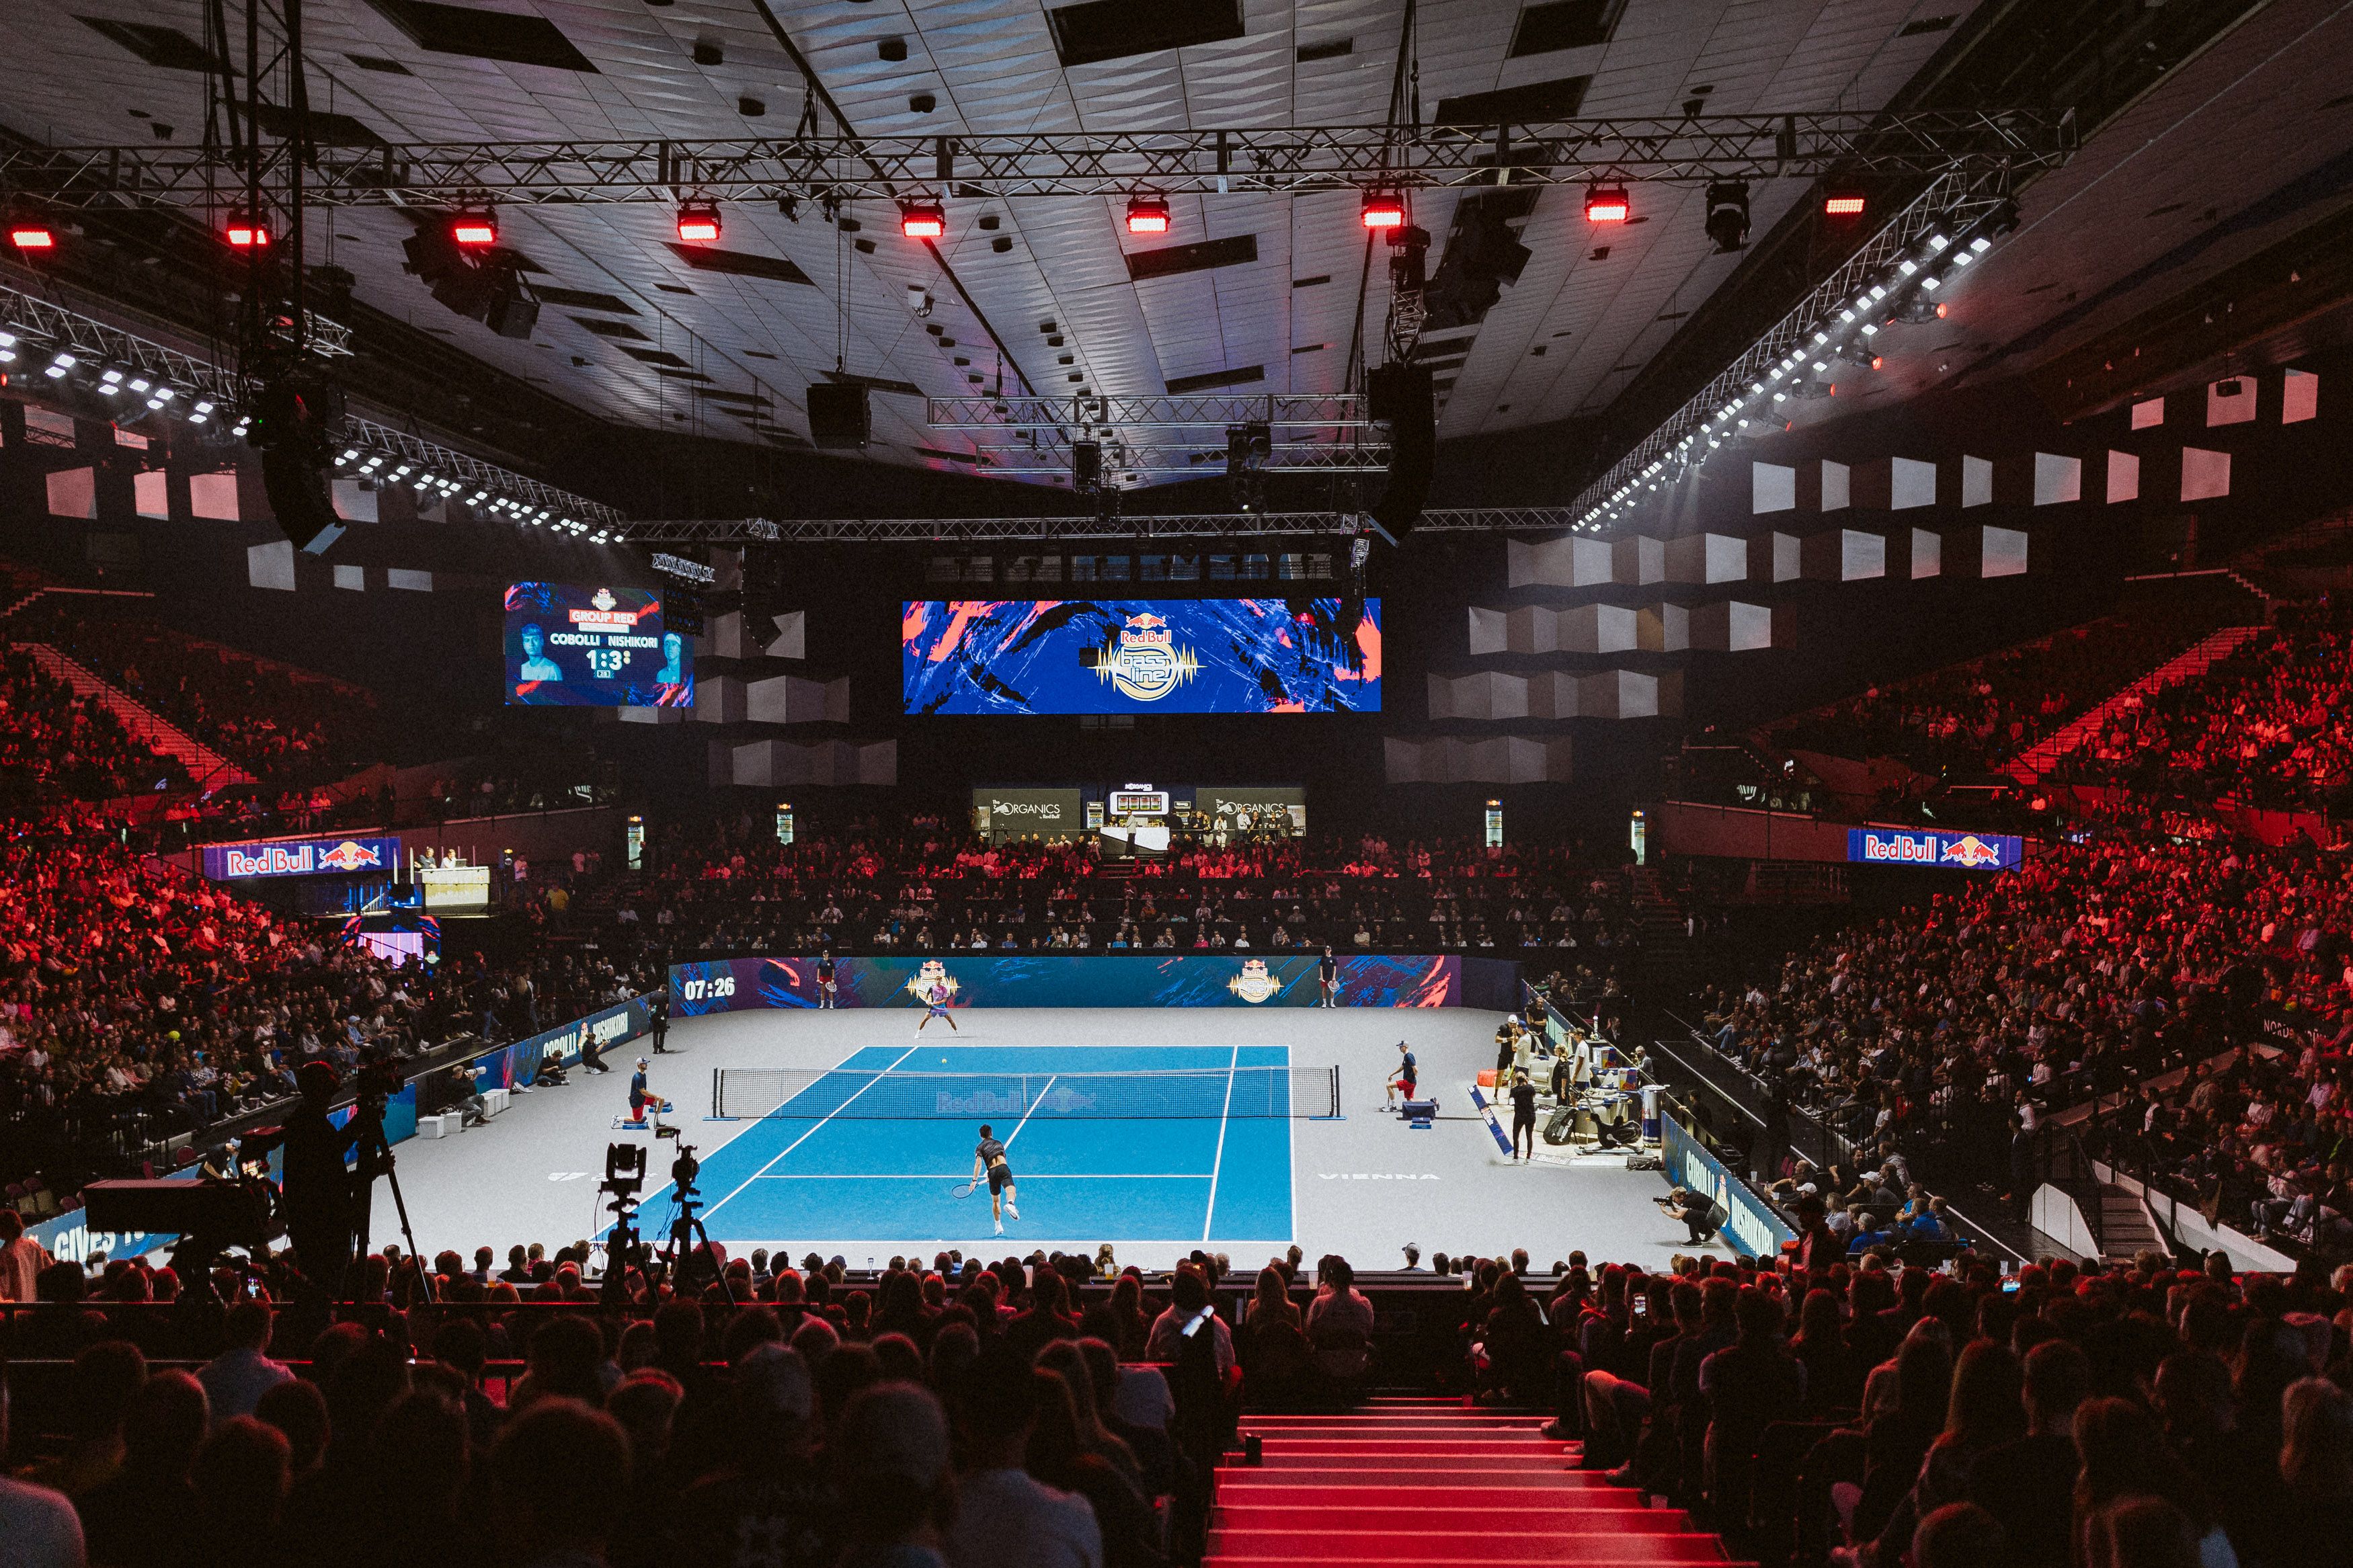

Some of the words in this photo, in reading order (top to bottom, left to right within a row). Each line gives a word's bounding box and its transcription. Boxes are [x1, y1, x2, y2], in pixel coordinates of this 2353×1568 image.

[572, 611, 611, 622] GROUP
[613, 613, 635, 623] RED
[550, 633, 600, 646] COBOLLI
[608, 636, 658, 648] NISHIKORI
[1121, 630, 1146, 643] Red
[1148, 630, 1171, 643] Bull
[1002, 802, 1060, 815] ORGANICS
[1866, 835, 1900, 858] Red
[1901, 837, 1936, 861] Bull
[229, 848, 271, 875] Red
[273, 846, 313, 872] Bull
[685, 977, 735, 1000] 07:26
[1686, 1150, 1714, 1201] COBOLLI
[1731, 1193, 1773, 1257] NISHIKORI
